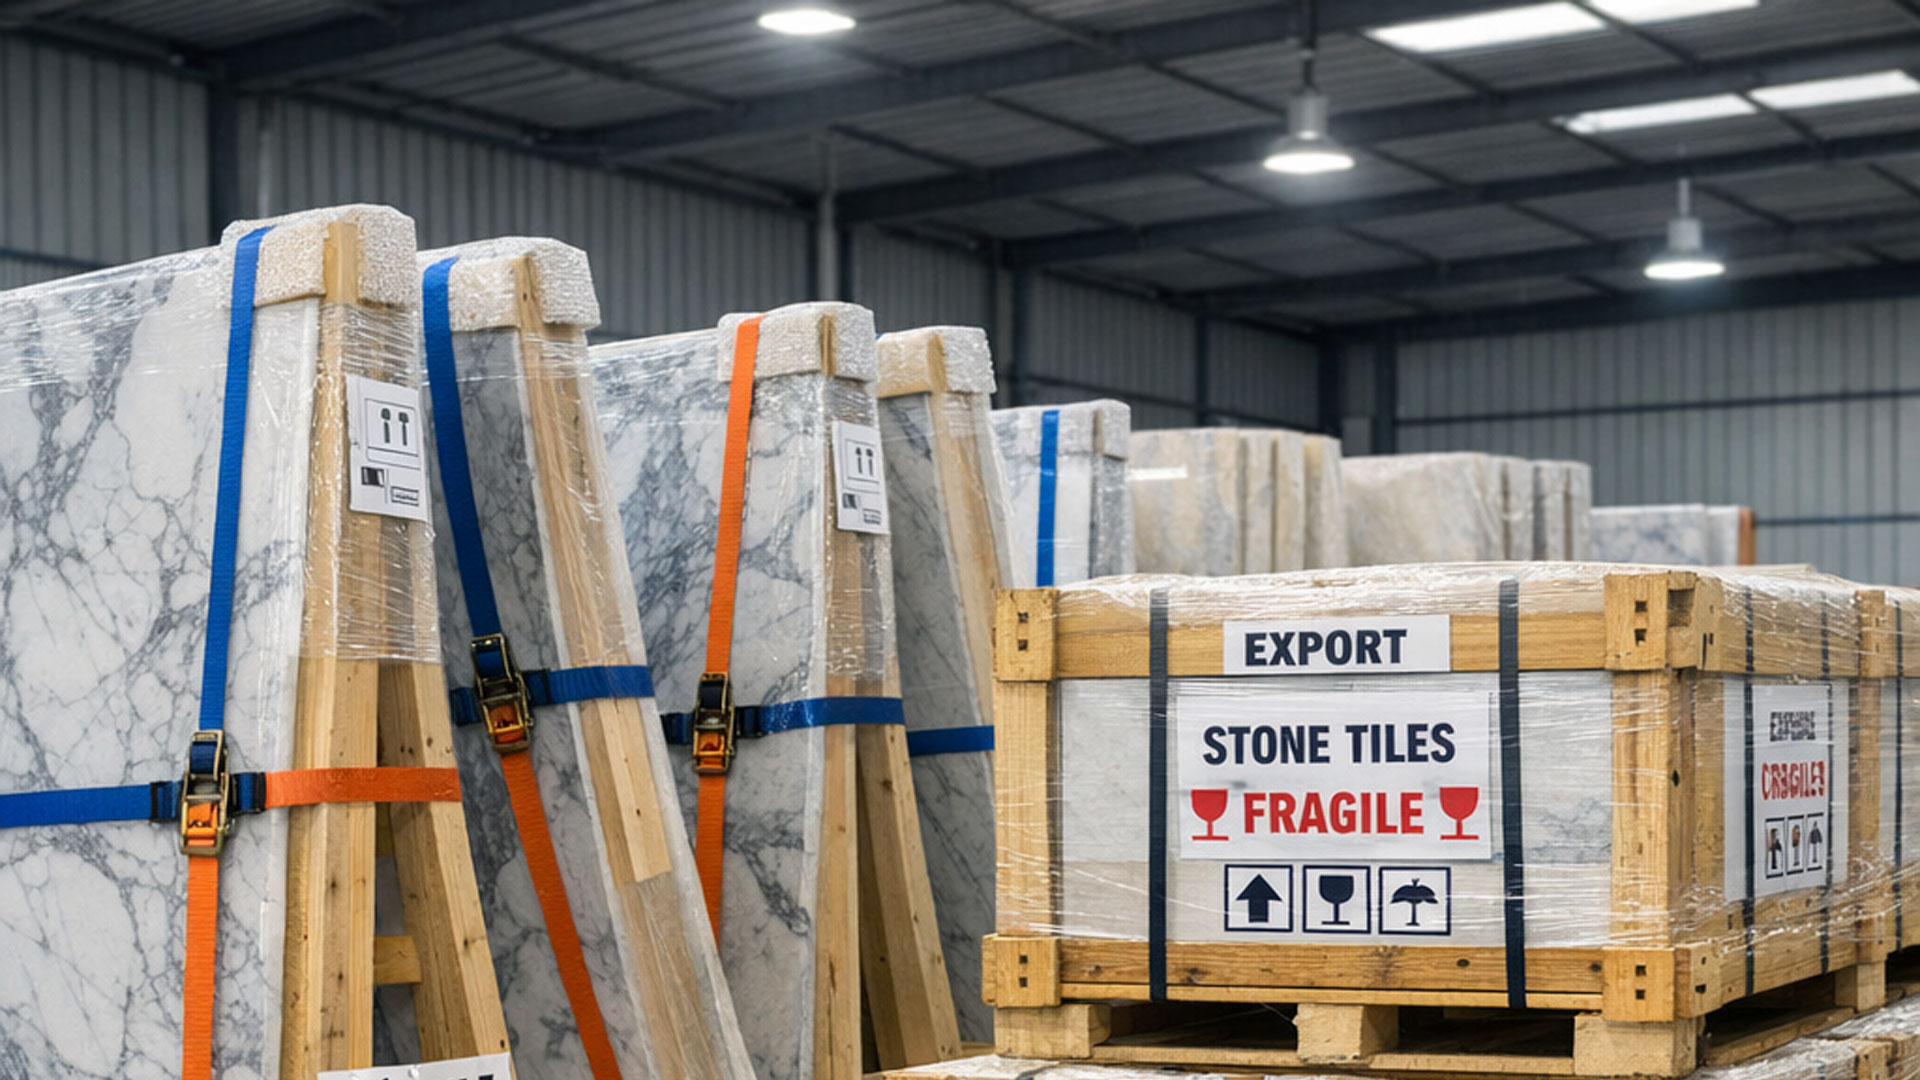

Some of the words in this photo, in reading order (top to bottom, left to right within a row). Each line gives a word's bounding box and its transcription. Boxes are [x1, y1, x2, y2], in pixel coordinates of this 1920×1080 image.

[1246, 630, 1407, 666] EXPORT
[1204, 726, 1330, 765] STONE
[1346, 723, 1455, 763] TILES
[1244, 792, 1424, 834] FRAGILE
